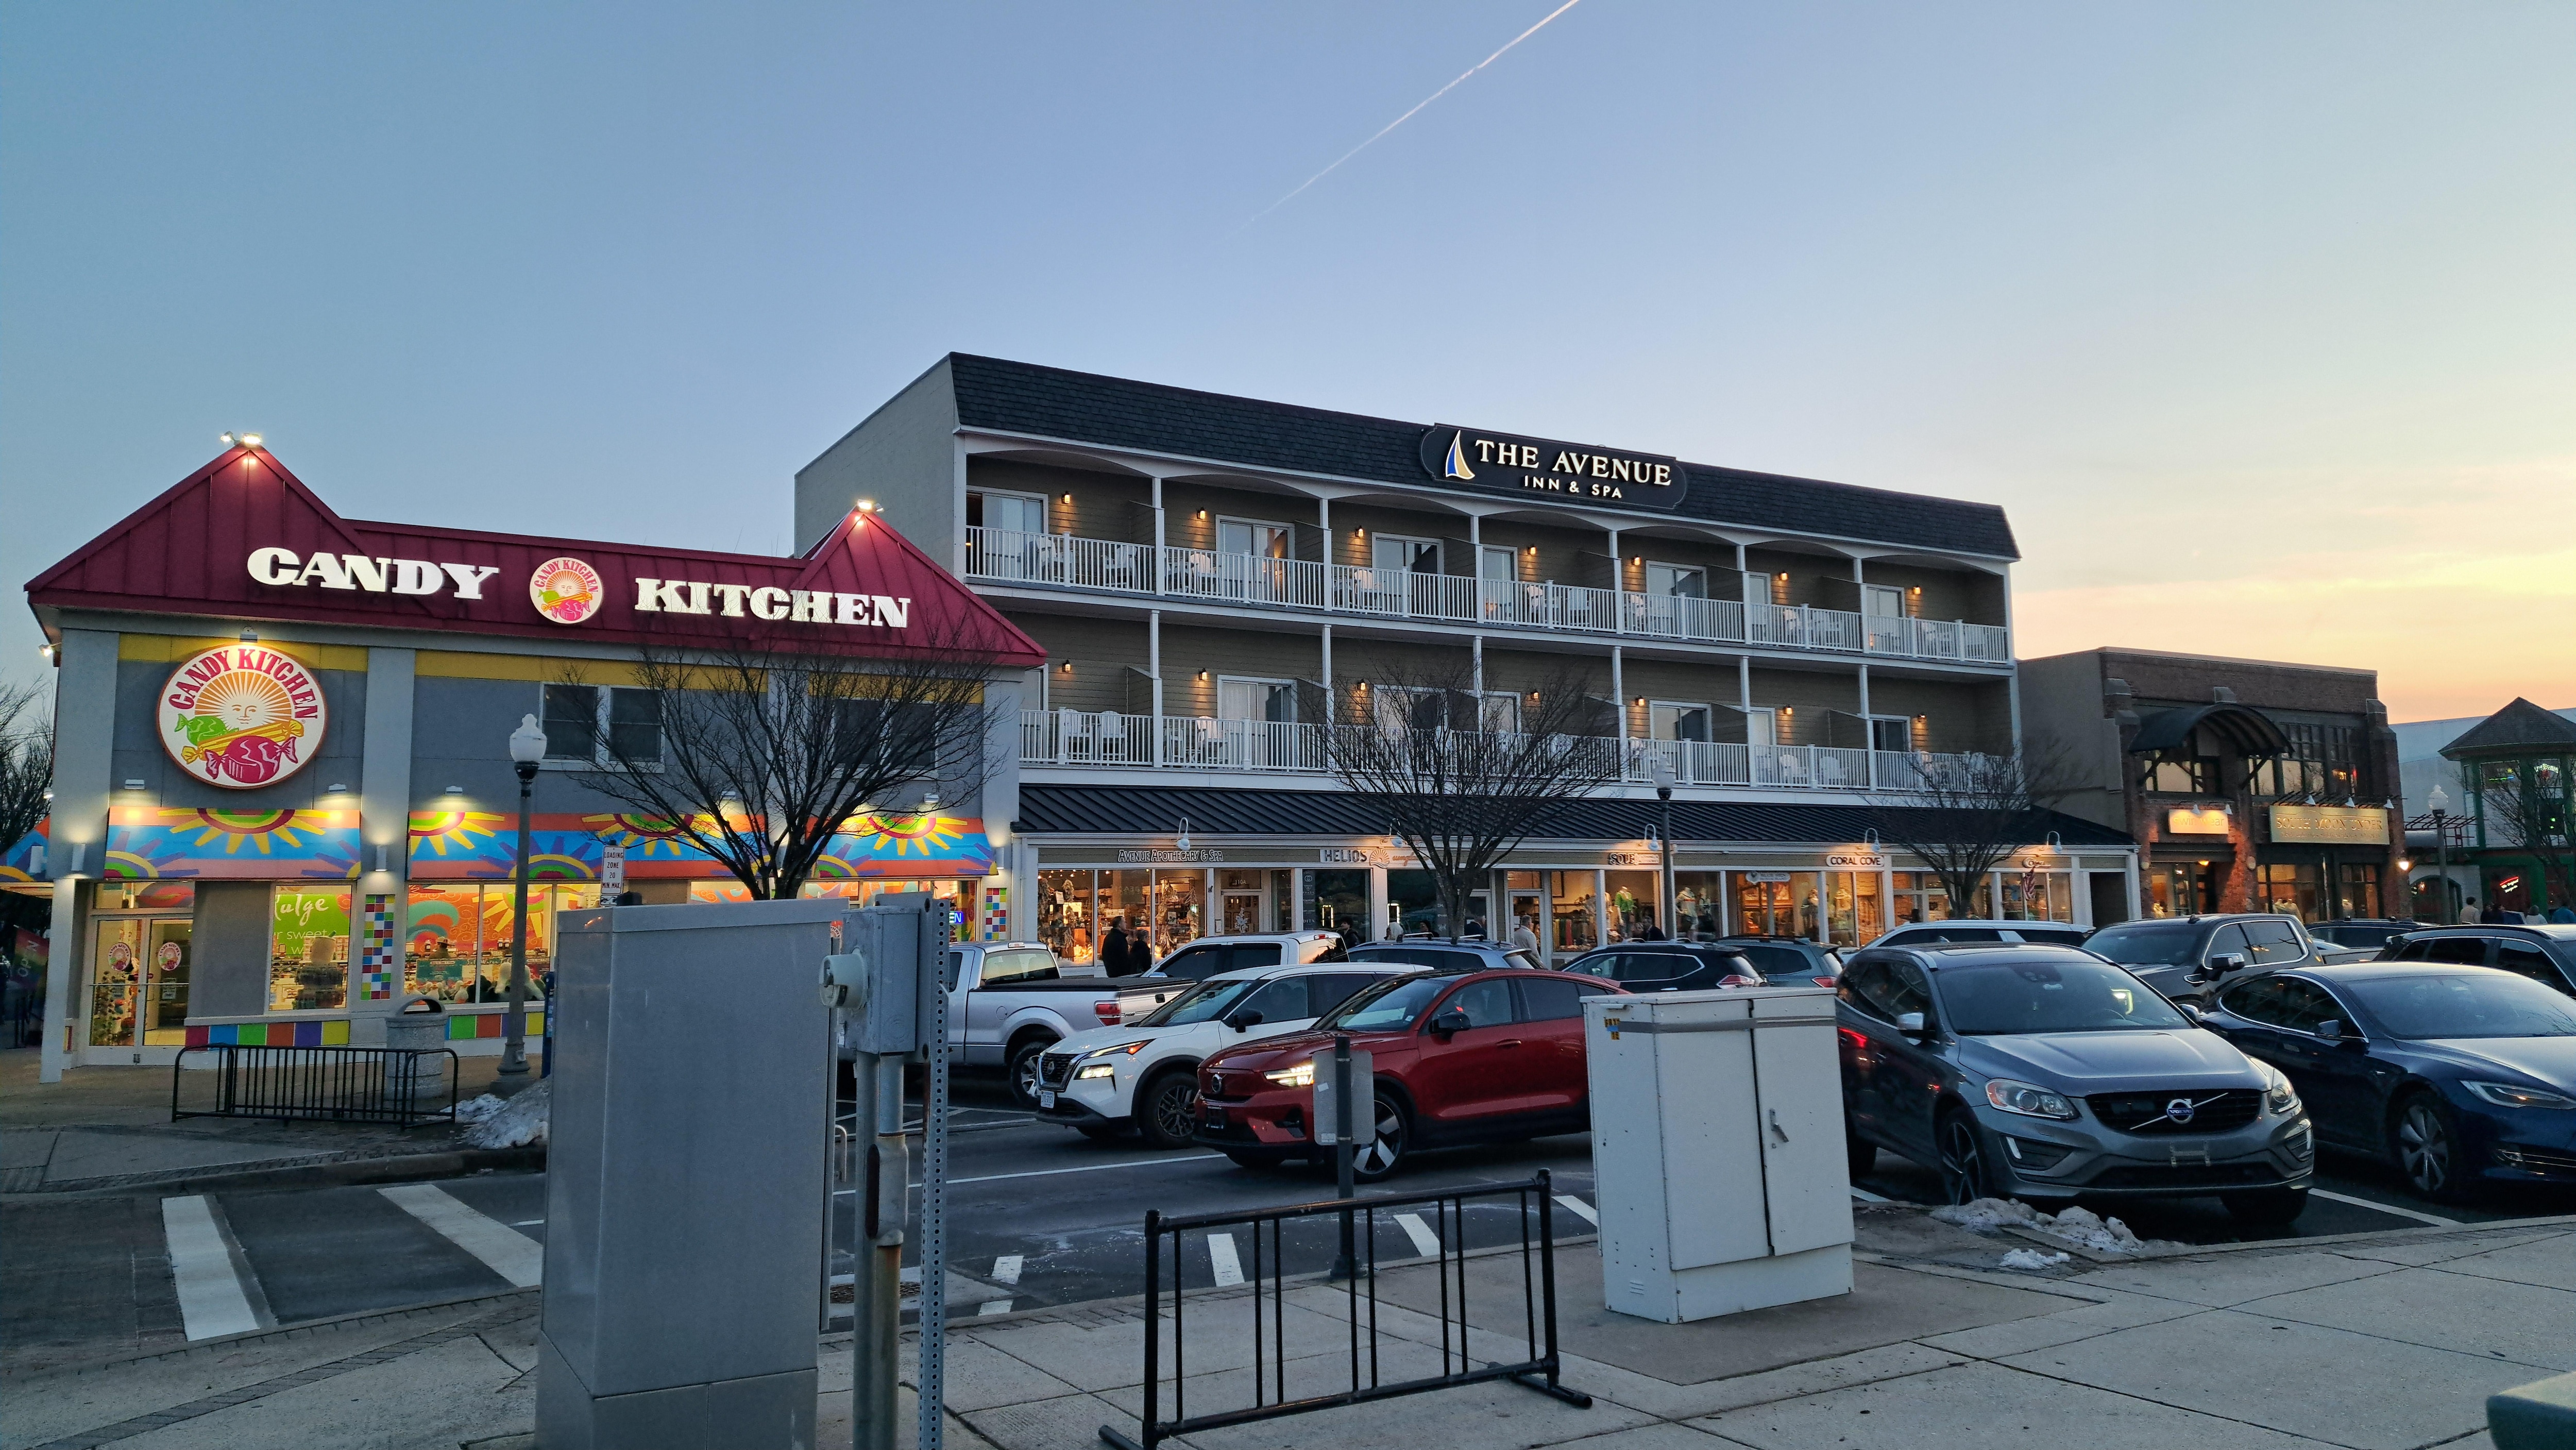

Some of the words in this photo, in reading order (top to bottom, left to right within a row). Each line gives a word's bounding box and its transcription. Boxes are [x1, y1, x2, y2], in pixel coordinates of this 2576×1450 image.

[1475, 439, 1539, 468] THE
[1552, 450, 1672, 486] AVENUE
[1524, 475, 1560, 491] INN
[1569, 481, 1580, 493] &
[1591, 483, 1622, 498] SPA
[247, 547, 499, 599] CANDY
[634, 577, 911, 628] KITCHEN
[534, 561, 560, 587] CANDY
[563, 560, 598, 592] KITCHEN
[168, 650, 231, 710] CANDY
[237, 648, 318, 719] KITCHEN
[2277, 817, 2311, 829] SOUTH
[2315, 818, 2346, 830] MOON
[2349, 819, 2382, 831] UNDER
[1324, 849, 1367, 862] HELIOS
[1831, 857, 1857, 865] CORAL
[949, 913, 961, 923] EN
